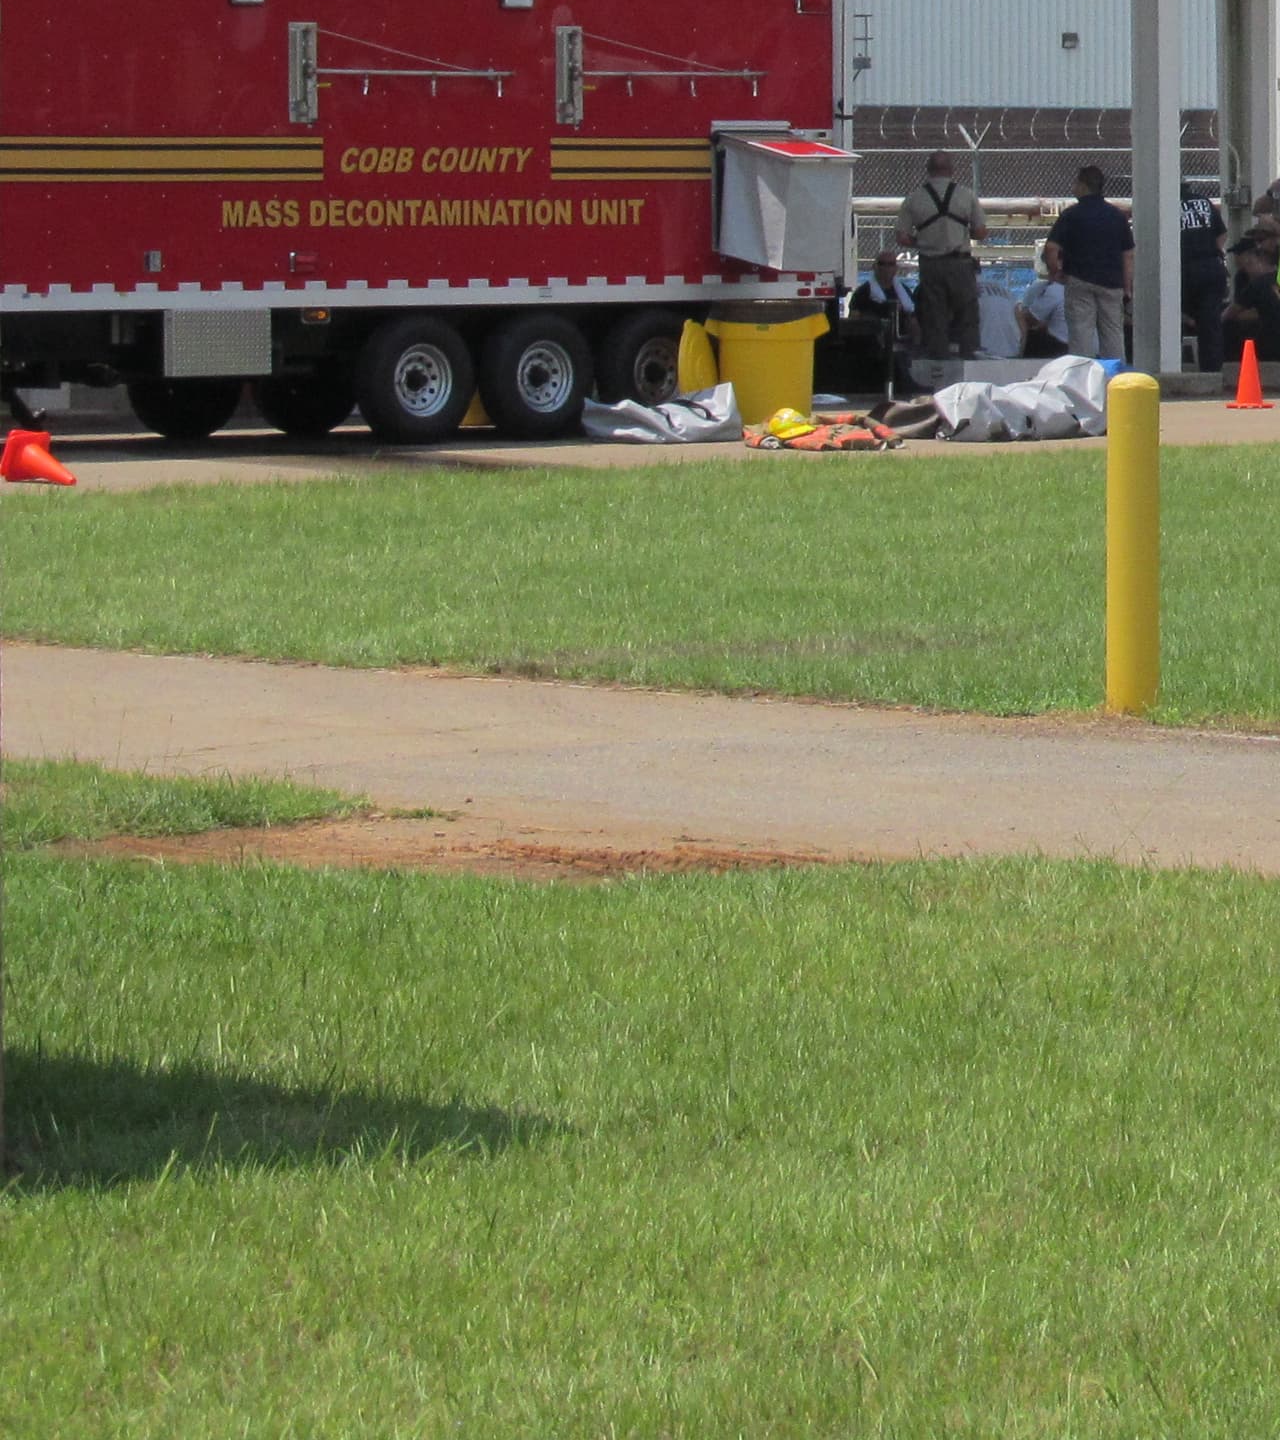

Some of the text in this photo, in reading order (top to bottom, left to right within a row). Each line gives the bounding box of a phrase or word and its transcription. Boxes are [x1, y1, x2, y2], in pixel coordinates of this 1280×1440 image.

[340, 146, 534, 173] COBB COUNTY
[222, 198, 645, 227] MASS DECONTAMINATION UNIT
